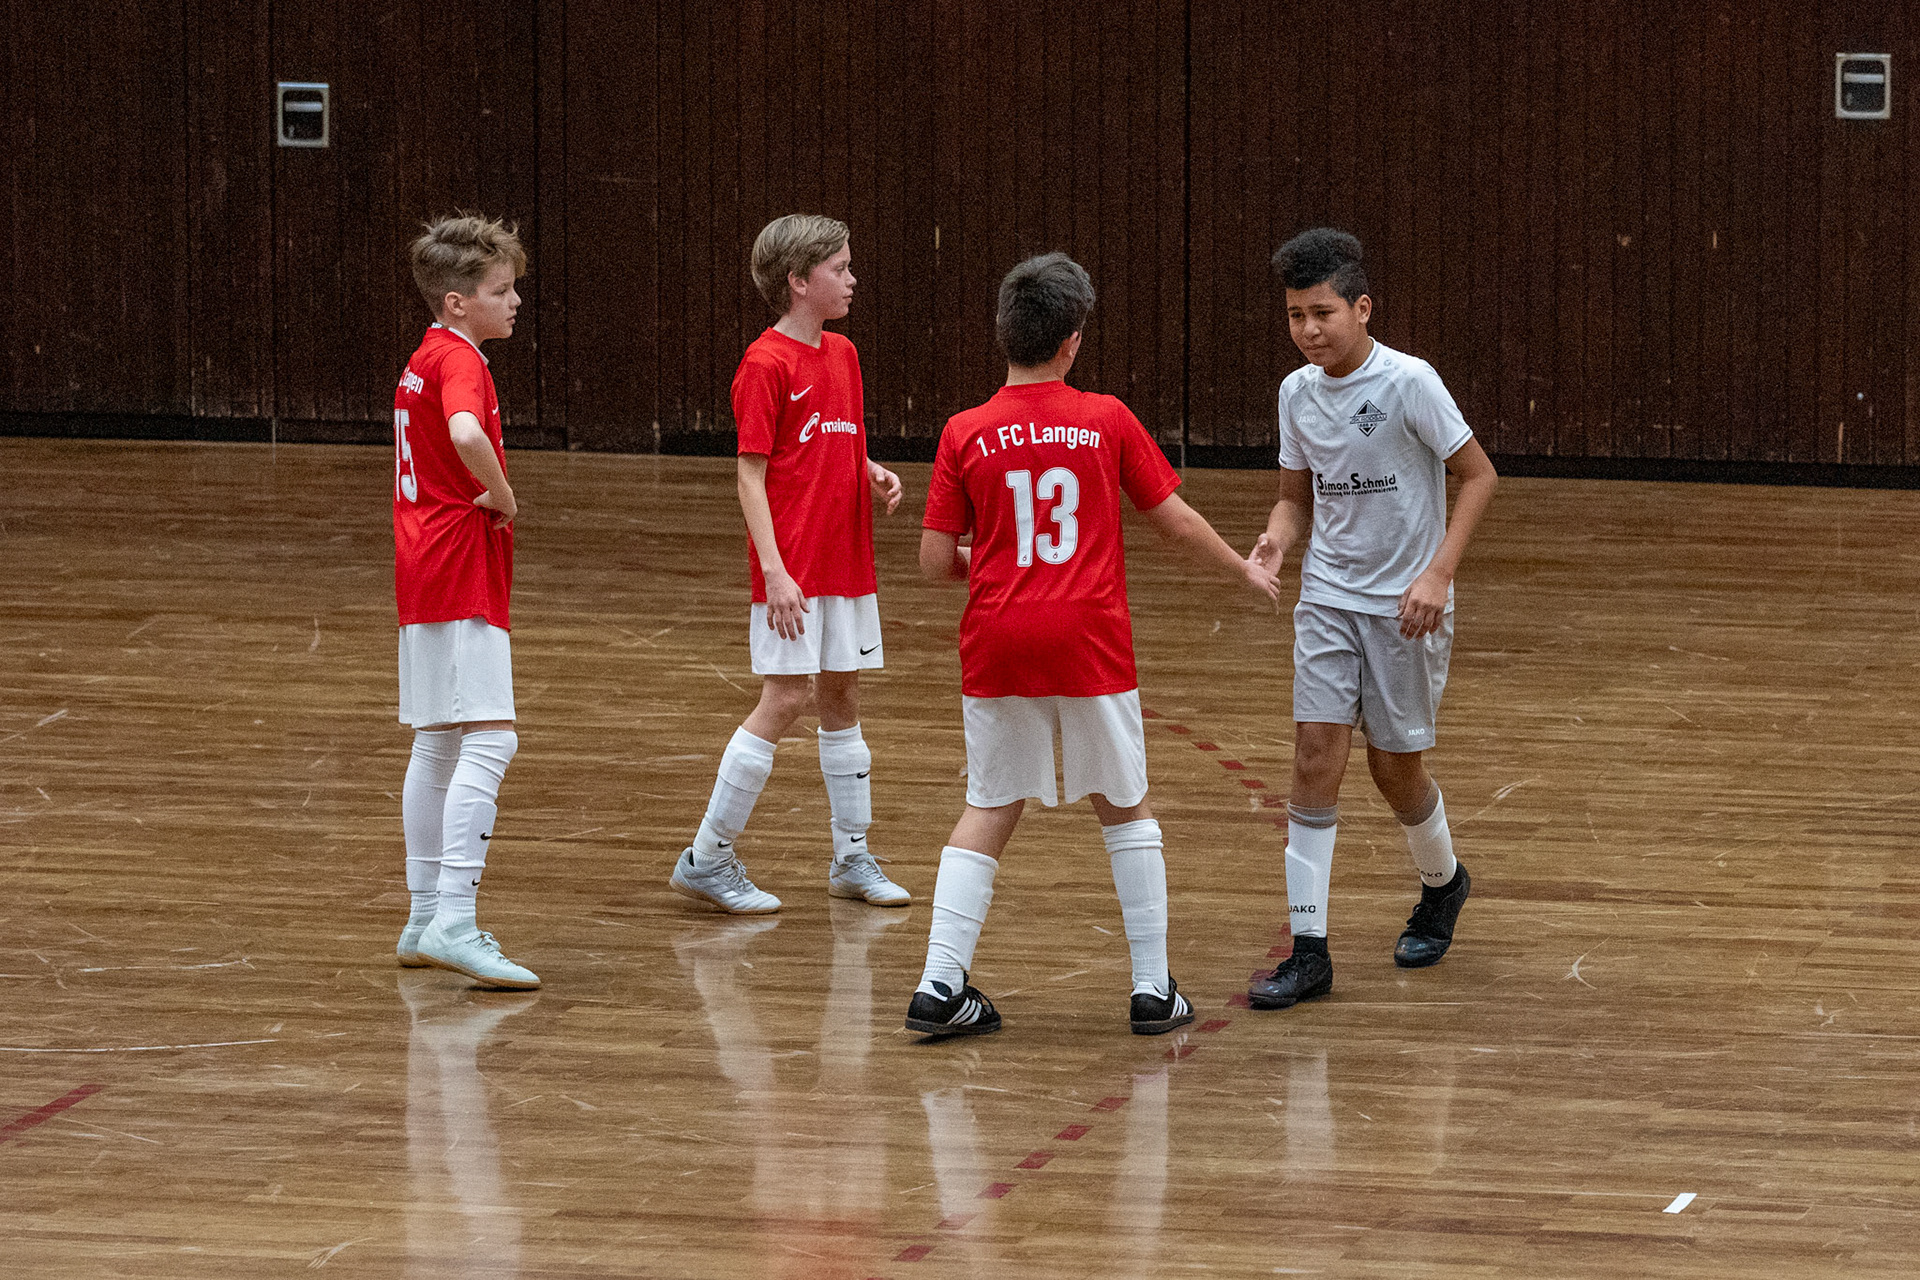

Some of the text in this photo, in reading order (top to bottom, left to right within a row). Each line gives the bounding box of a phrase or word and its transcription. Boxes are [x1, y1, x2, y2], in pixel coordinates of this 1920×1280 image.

[976, 422, 1101, 458] 1. FC Langen
[394, 408, 418, 503] 15
[1316, 472, 1396, 491] Simon Schmid
[1005, 466, 1080, 568] 13
[1408, 728, 1425, 736] JAKO
[1289, 904, 1316, 913] JAKO
